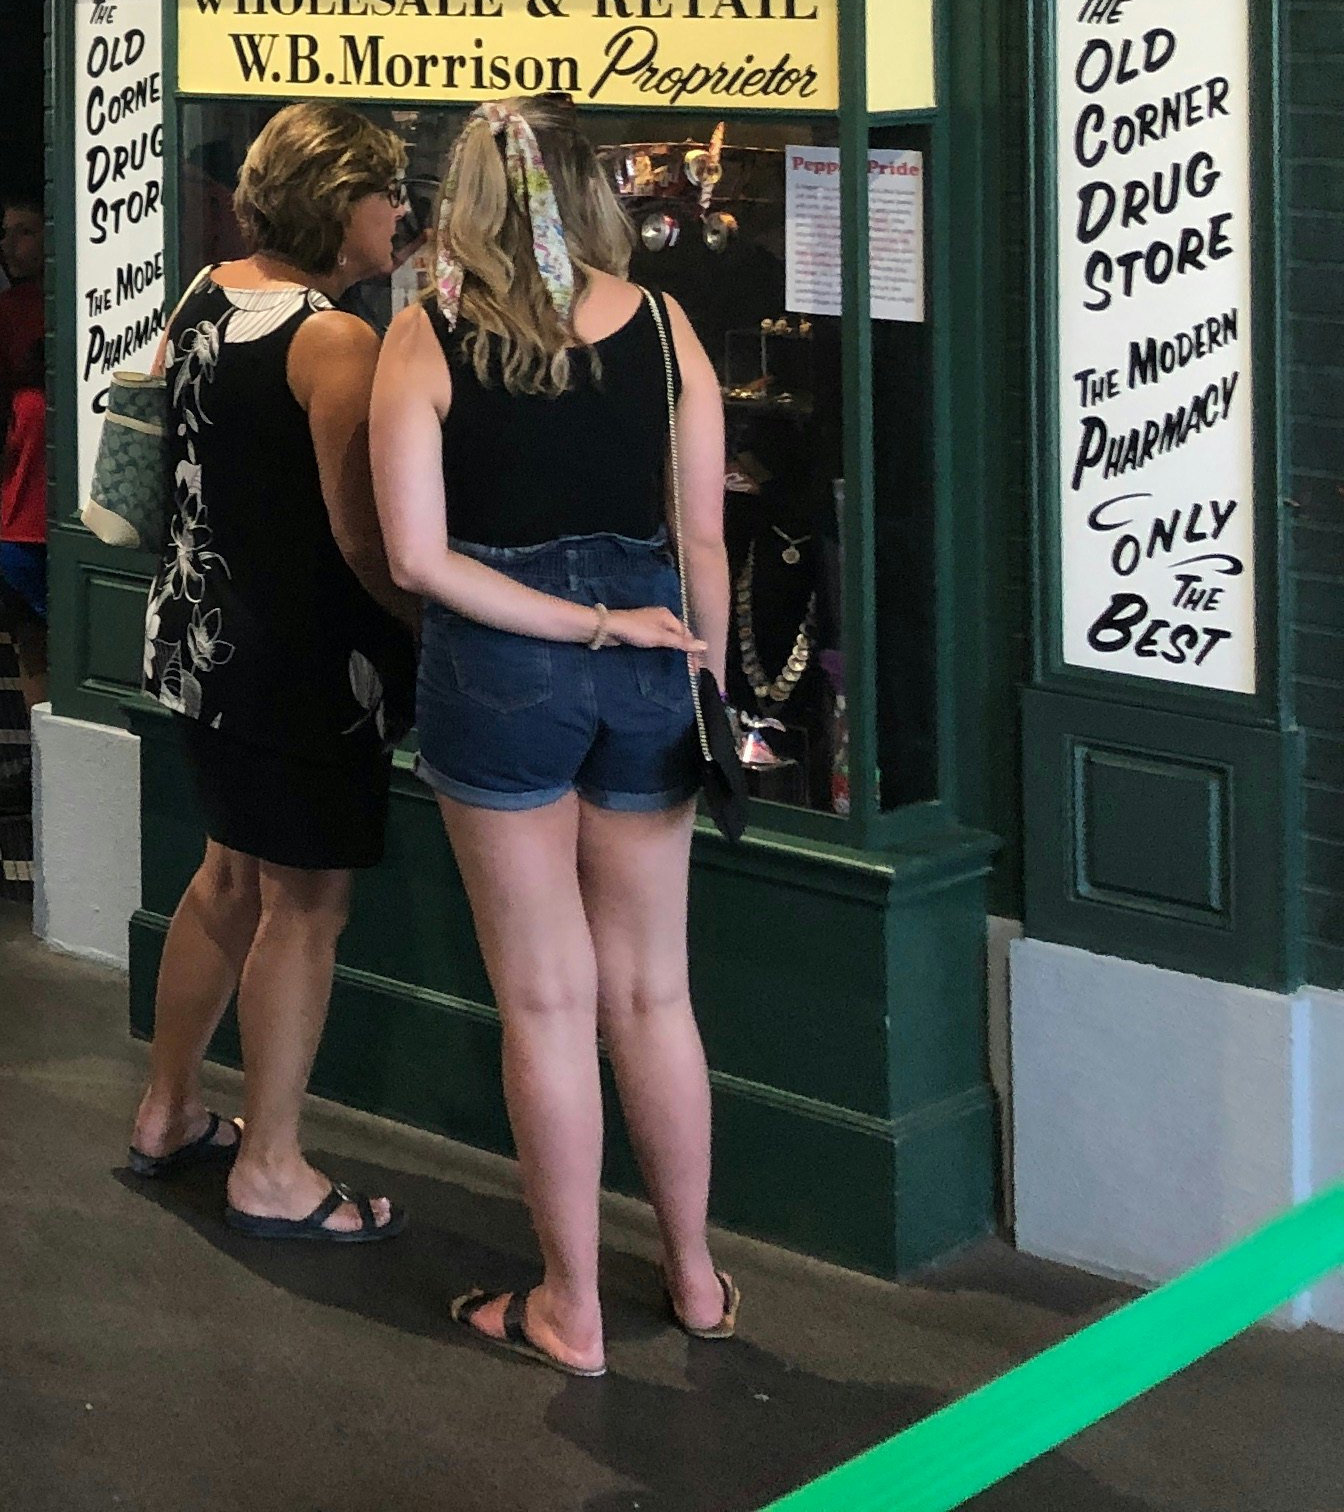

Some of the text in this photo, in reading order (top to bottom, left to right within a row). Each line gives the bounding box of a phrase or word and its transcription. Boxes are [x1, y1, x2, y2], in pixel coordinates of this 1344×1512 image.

[86, 28, 145, 79] OLD
[589, 25, 818, 98] Proprietor
[1075, 28, 1175, 93] OLD
[86, 72, 161, 136] CORNE
[1074, 77, 1230, 168] CORNER
[86, 123, 163, 194] DRUG
[792, 156, 920, 176] Pepp Pride
[89, 180, 163, 245] STOR
[1077, 151, 1221, 244] DRUG
[85, 252, 163, 318] THE MODE
[1083, 212, 1233, 311] STORE
[83, 300, 165, 382] PHARMAC
[1073, 308, 1238, 408] THE MODERN
[1071, 371, 1240, 491] PHARMACY
[1112, 499, 1238, 576] ONLY
[1172, 574, 1225, 611] THE
[1087, 593, 1233, 666] BEST
